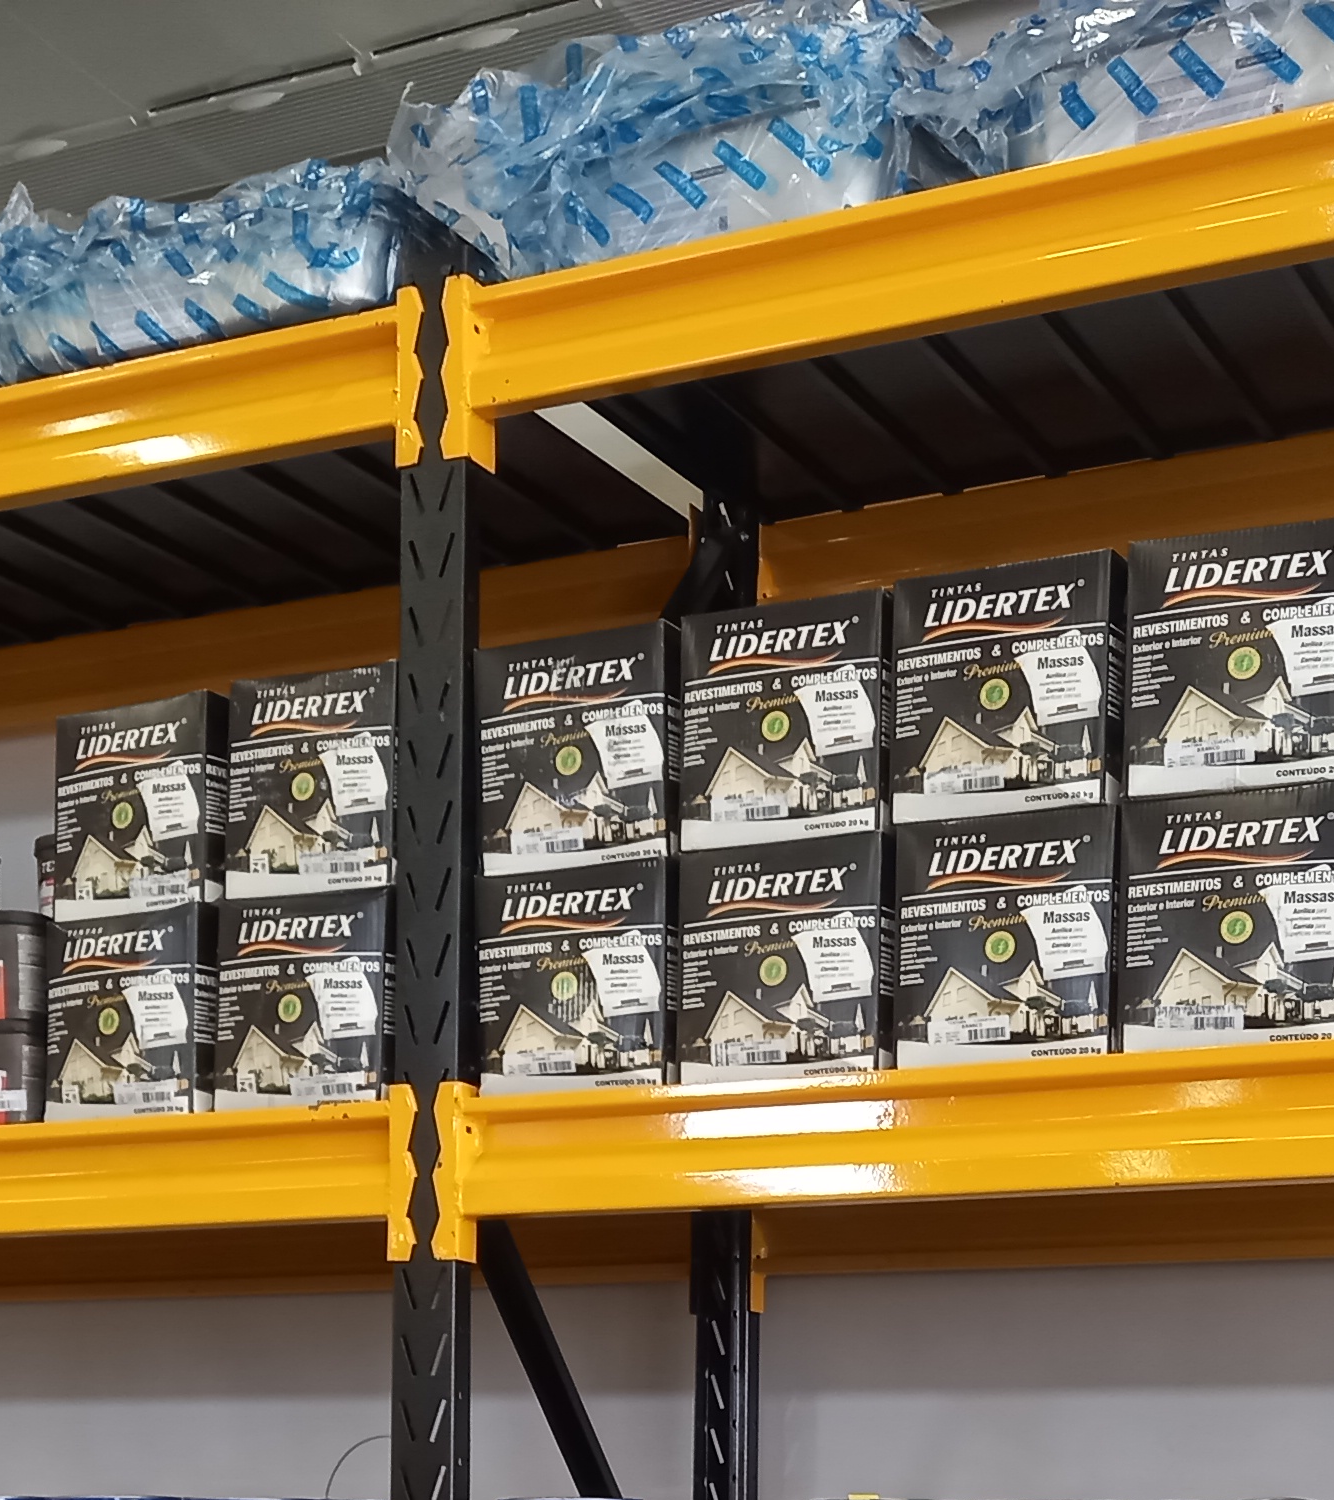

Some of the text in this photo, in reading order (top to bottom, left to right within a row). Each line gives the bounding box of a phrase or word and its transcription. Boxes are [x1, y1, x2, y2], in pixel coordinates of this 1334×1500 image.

[1164, 551, 1330, 594] LIDERTEX
[1172, 548, 1229, 562] TINTAS
[924, 585, 1073, 628] LIDERTEX
[709, 620, 851, 662] LIDERTEX
[716, 619, 763, 633] TINTAS
[503, 657, 633, 699] LIDERTEX
[685, 667, 877, 703] REVESTIMENTOS & COMPLEMENTOS
[815, 688, 859, 702] Massas
[252, 691, 367, 725] LIDERTEX
[336, 753, 373, 766] Massas
[928, 840, 1078, 877] LIDERTEX
[707, 867, 846, 905] LIDERTEX
[63, 928, 166, 963] LIDERTEX
[238, 914, 355, 945] LIDERTEX
